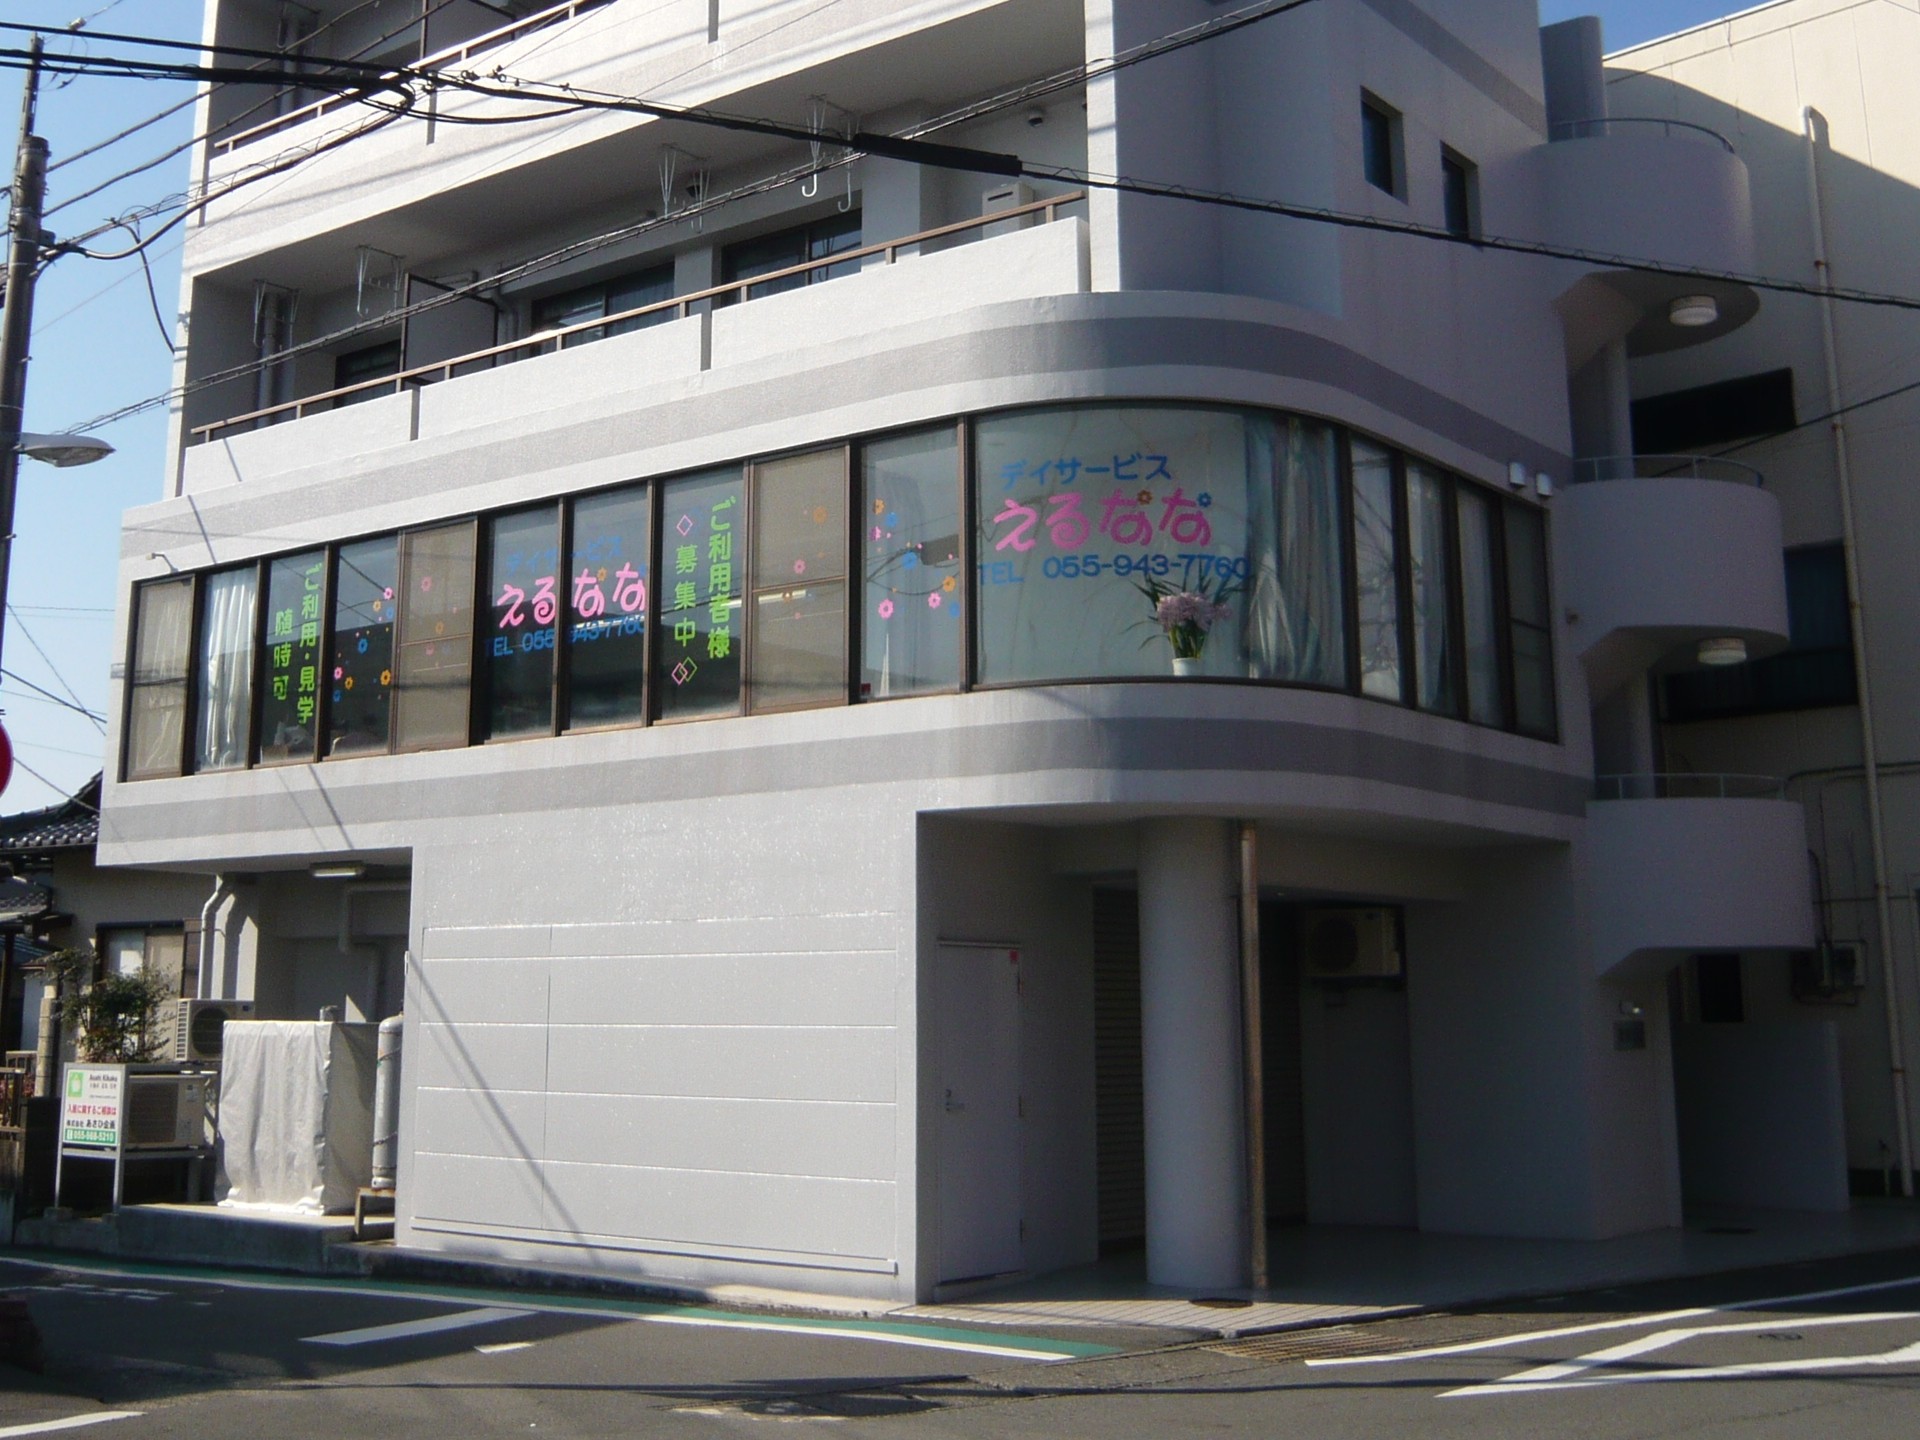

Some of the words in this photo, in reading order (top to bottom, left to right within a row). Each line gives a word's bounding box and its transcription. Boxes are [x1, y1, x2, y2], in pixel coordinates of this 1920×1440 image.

[993, 487, 1211, 552] えるなな
[496, 561, 645, 629] えるなな
[674, 544, 698, 647] 募集中
[707, 495, 737, 659] ご利用者様
[978, 561, 1025, 586] TEL
[1042, 554, 1250, 579] 055-943-7760
[273, 608, 293, 701] 随時可
[297, 562, 322, 724] ご利用・見学
